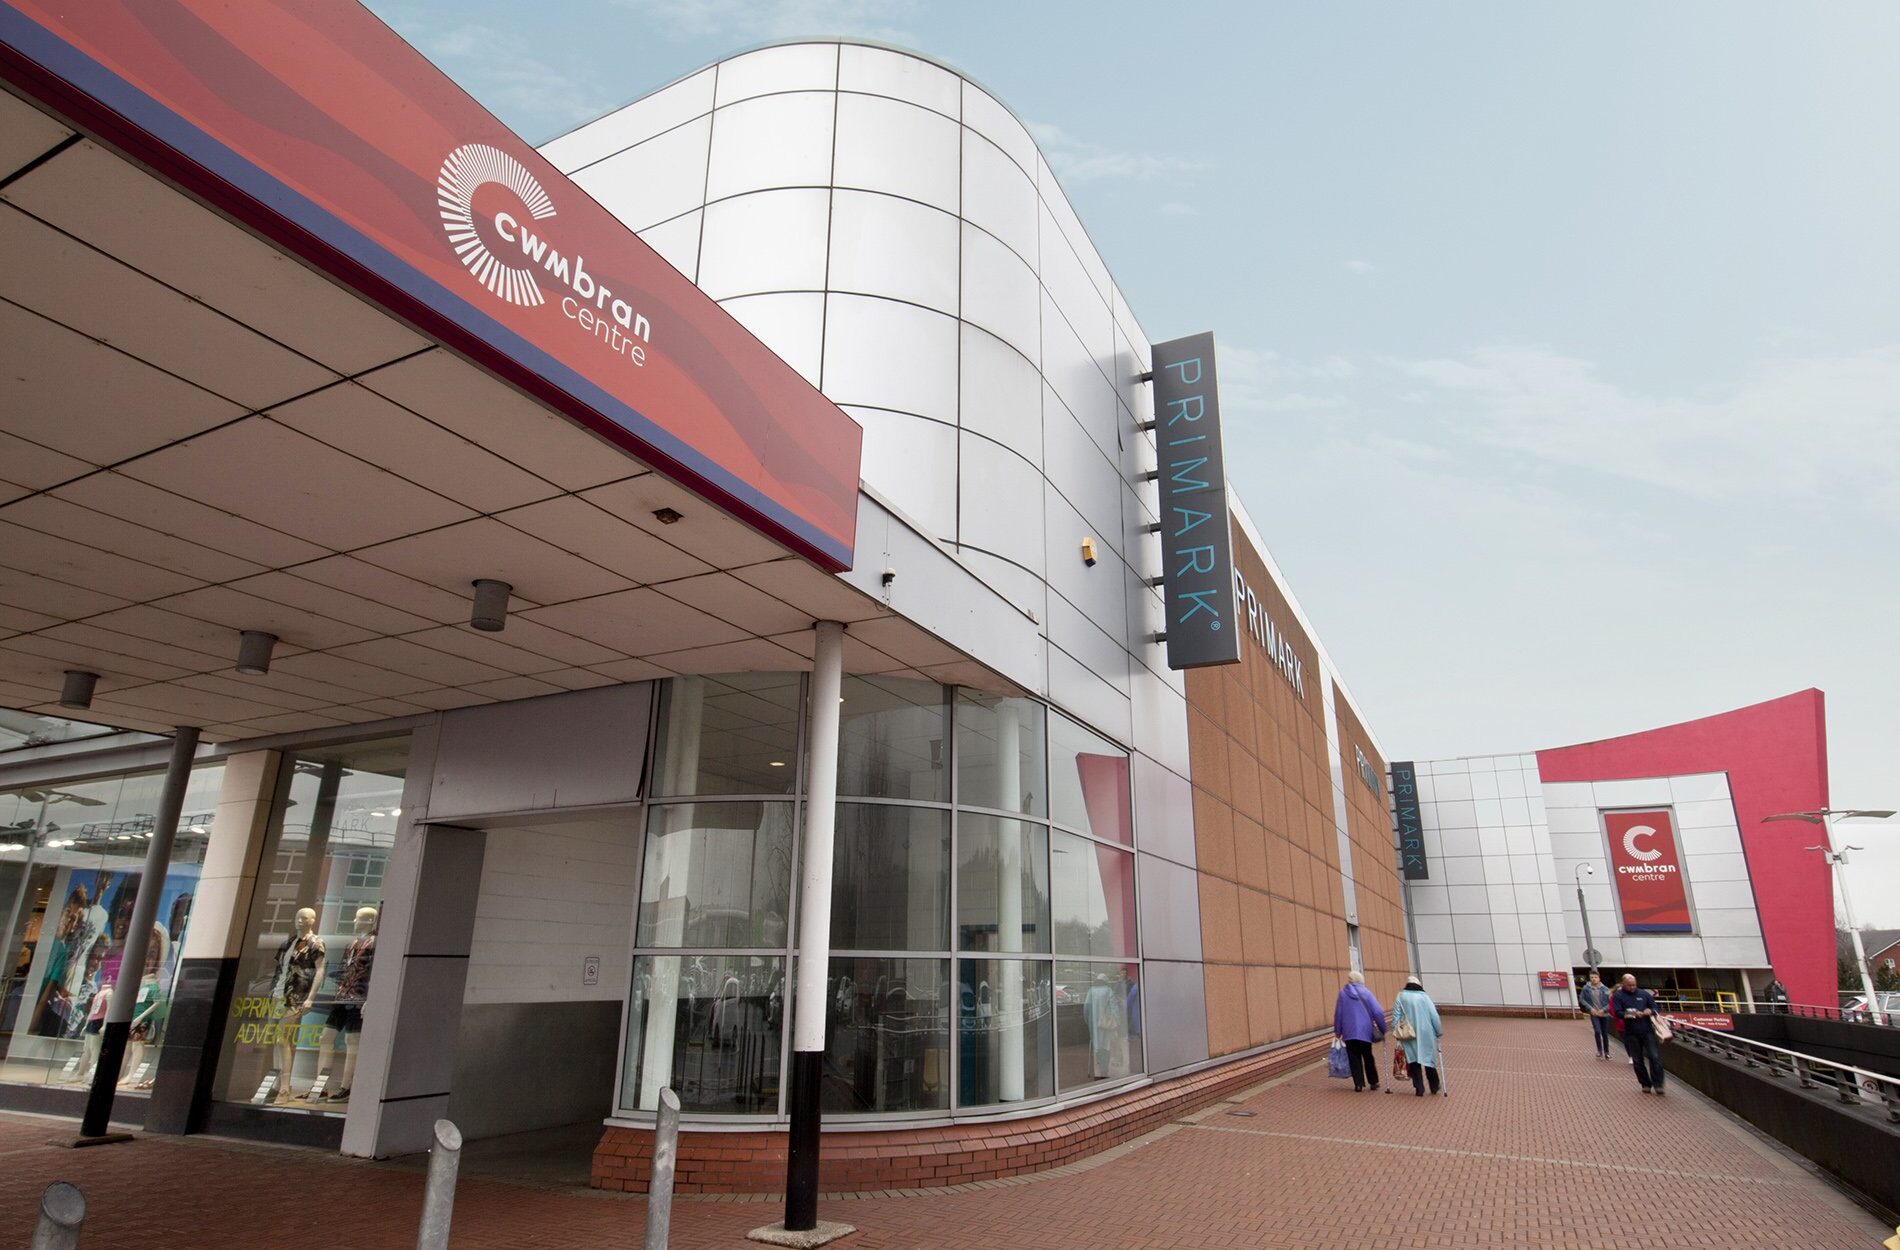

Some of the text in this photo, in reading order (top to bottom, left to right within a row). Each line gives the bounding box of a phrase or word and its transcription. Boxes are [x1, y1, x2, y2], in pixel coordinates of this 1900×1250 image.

[495, 212, 650, 343] cwmbran
[562, 297, 646, 366] centre
[1235, 567, 1304, 699] PRIMARK
[1618, 863, 1676, 873] cwmbran
[1632, 873, 1665, 881] centre
[231, 997, 287, 1019] SPRING
[234, 1024, 322, 1046] ADVENTURE
